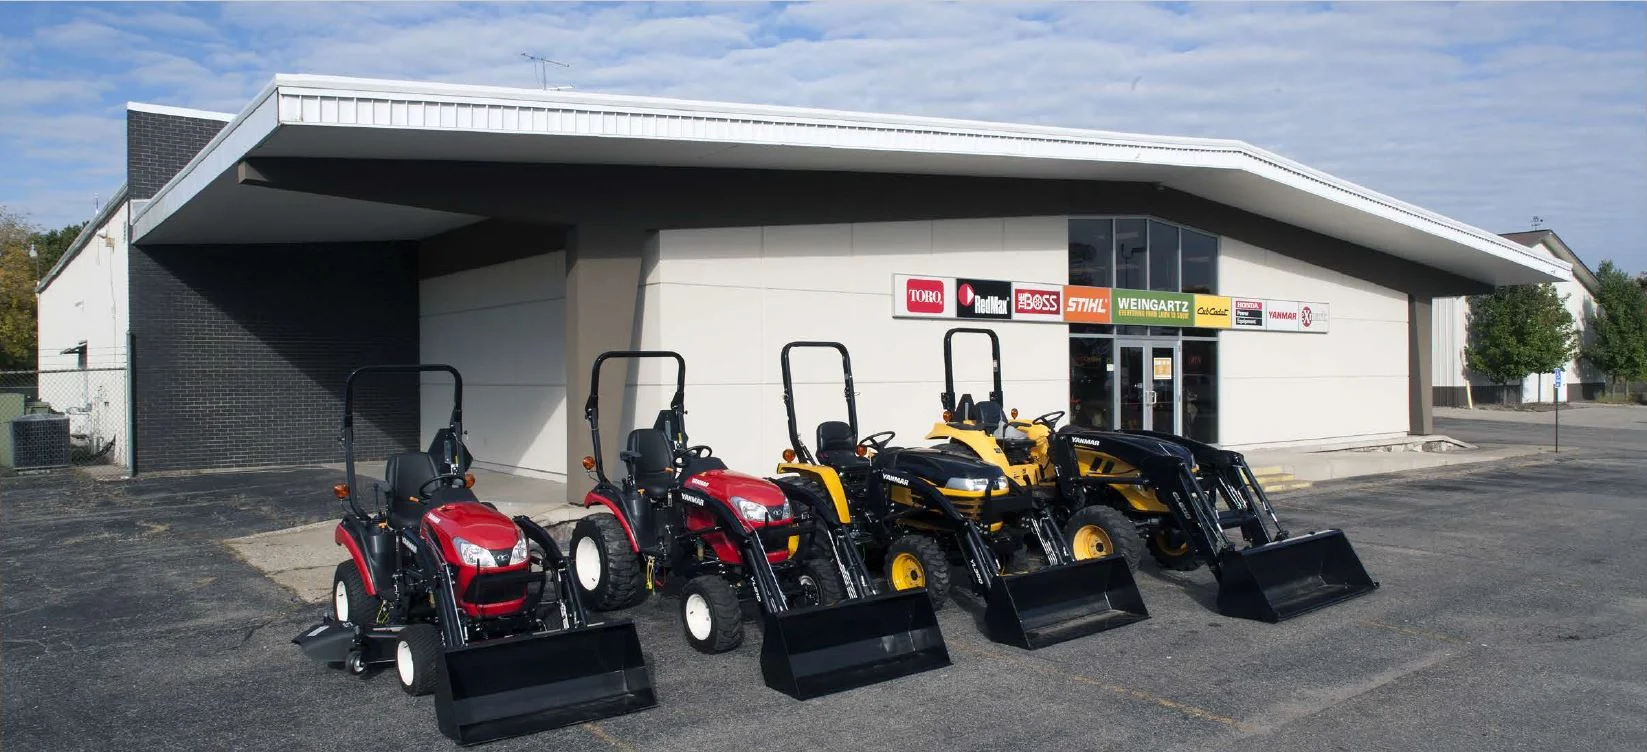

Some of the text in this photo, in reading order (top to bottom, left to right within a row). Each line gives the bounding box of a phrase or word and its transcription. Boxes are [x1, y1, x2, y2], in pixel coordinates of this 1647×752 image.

[909, 289, 940, 303] TORO
[1018, 293, 1026, 309] THE
[1026, 293, 1058, 311] BOSS
[974, 295, 1008, 315] RedMax
[1067, 297, 1106, 313] STIHL
[1118, 297, 1189, 312] WEINGARTZ
[1268, 311, 1297, 320] YANMAR
[1071, 437, 1100, 446] YANMAR
[882, 472, 909, 486] YANMAR
[681, 492, 705, 507] YANMAR
